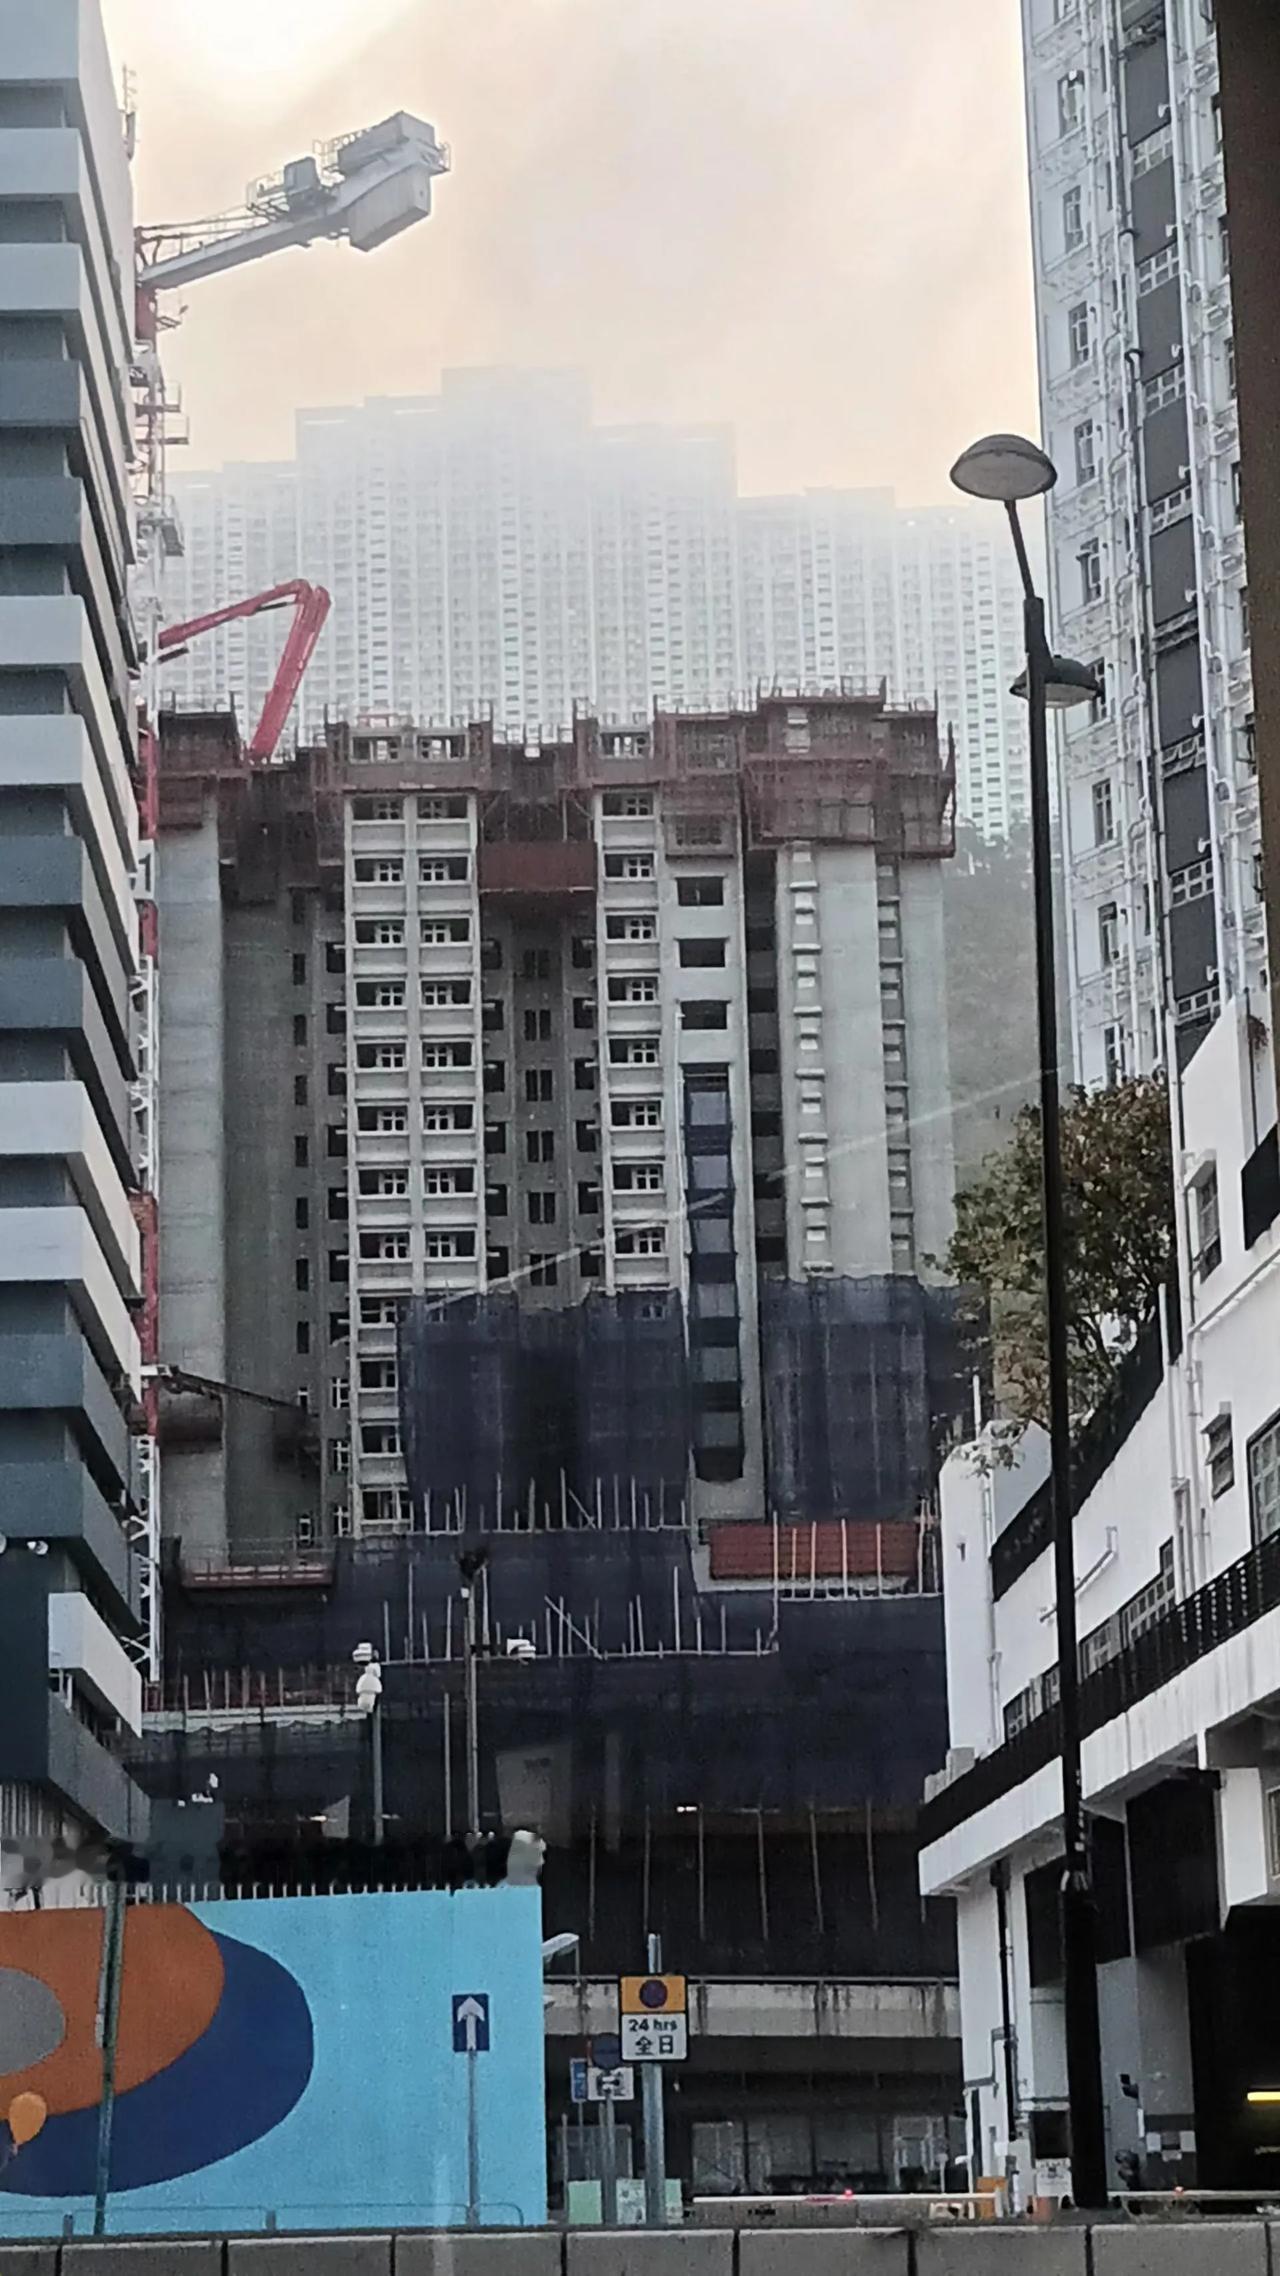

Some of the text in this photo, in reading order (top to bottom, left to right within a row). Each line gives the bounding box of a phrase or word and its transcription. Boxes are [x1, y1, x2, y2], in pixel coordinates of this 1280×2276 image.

[628, 2018, 678, 2032] 24 hrs
[634, 2034, 674, 2056] 全日
